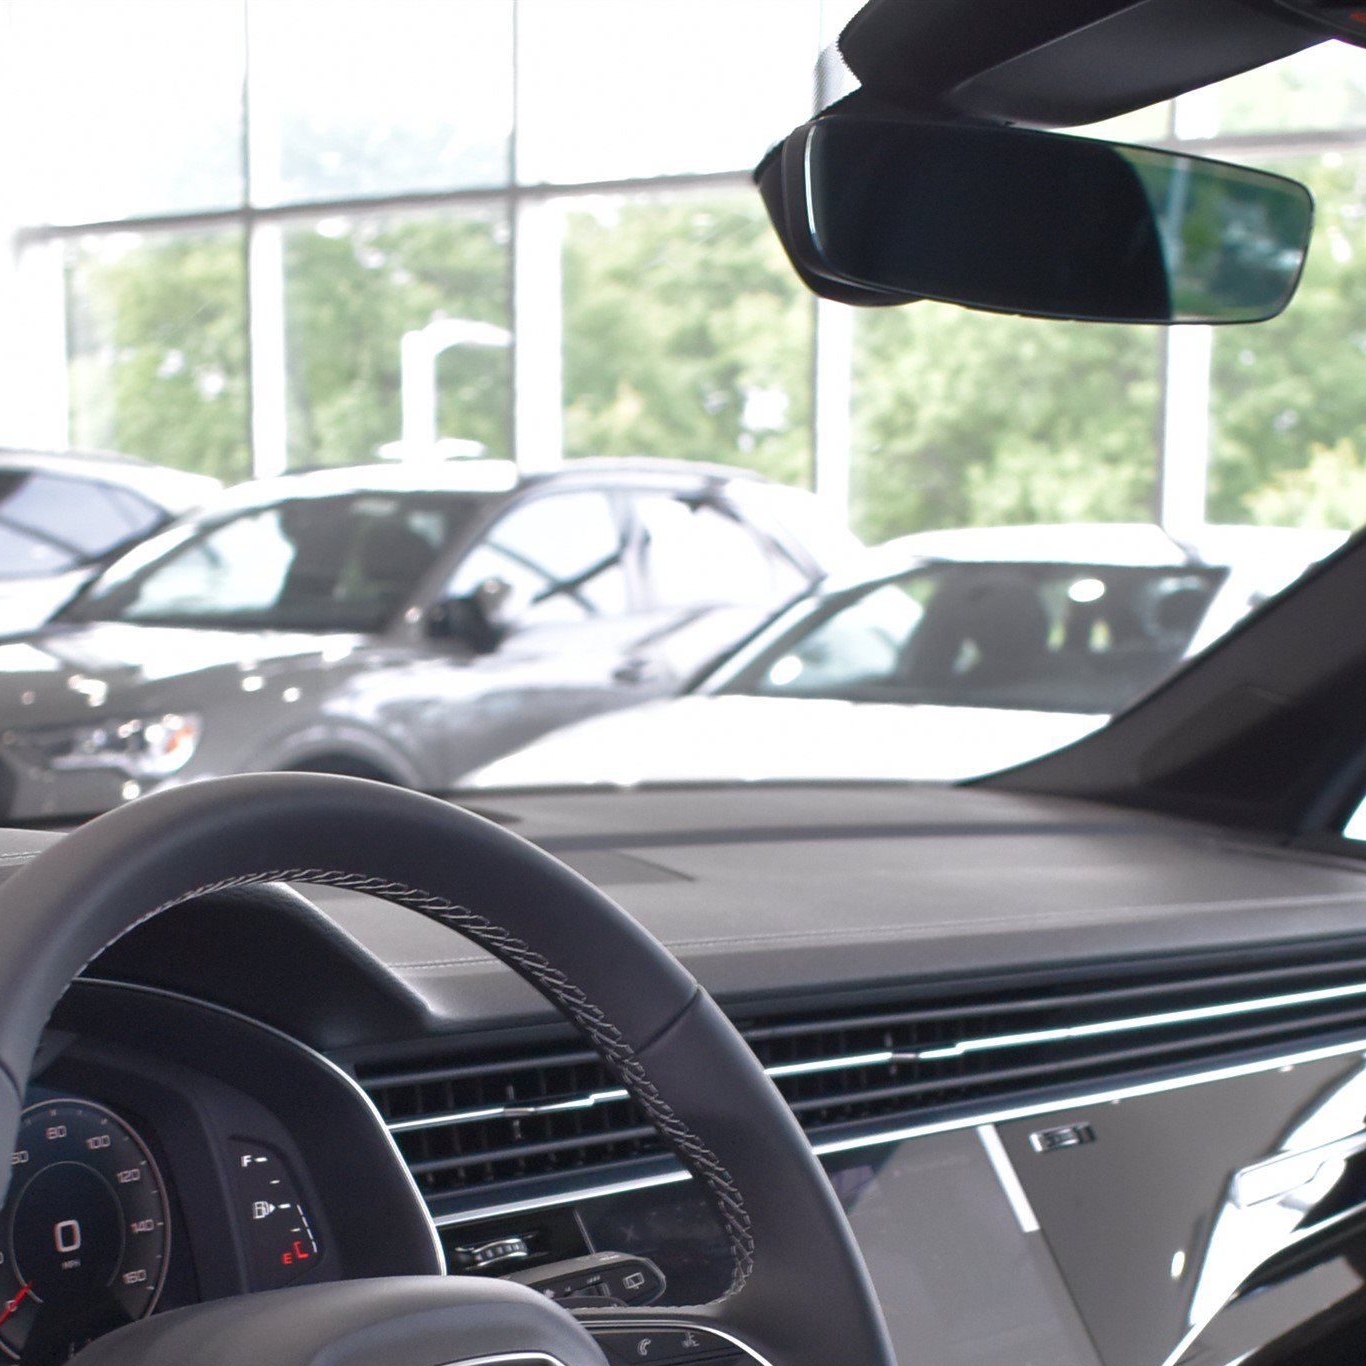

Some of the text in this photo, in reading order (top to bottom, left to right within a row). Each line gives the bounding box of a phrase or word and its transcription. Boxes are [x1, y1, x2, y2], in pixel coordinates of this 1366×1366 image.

[44, 1125, 68, 1140] 80
[86, 1134, 111, 1150] 100
[241, 1154, 252, 1167] F
[116, 1168, 141, 1184] 120
[130, 1218, 155, 1234] 140
[53, 1219, 82, 1253] 0
[282, 1253, 293, 1264] E
[122, 1269, 147, 1285] 160
